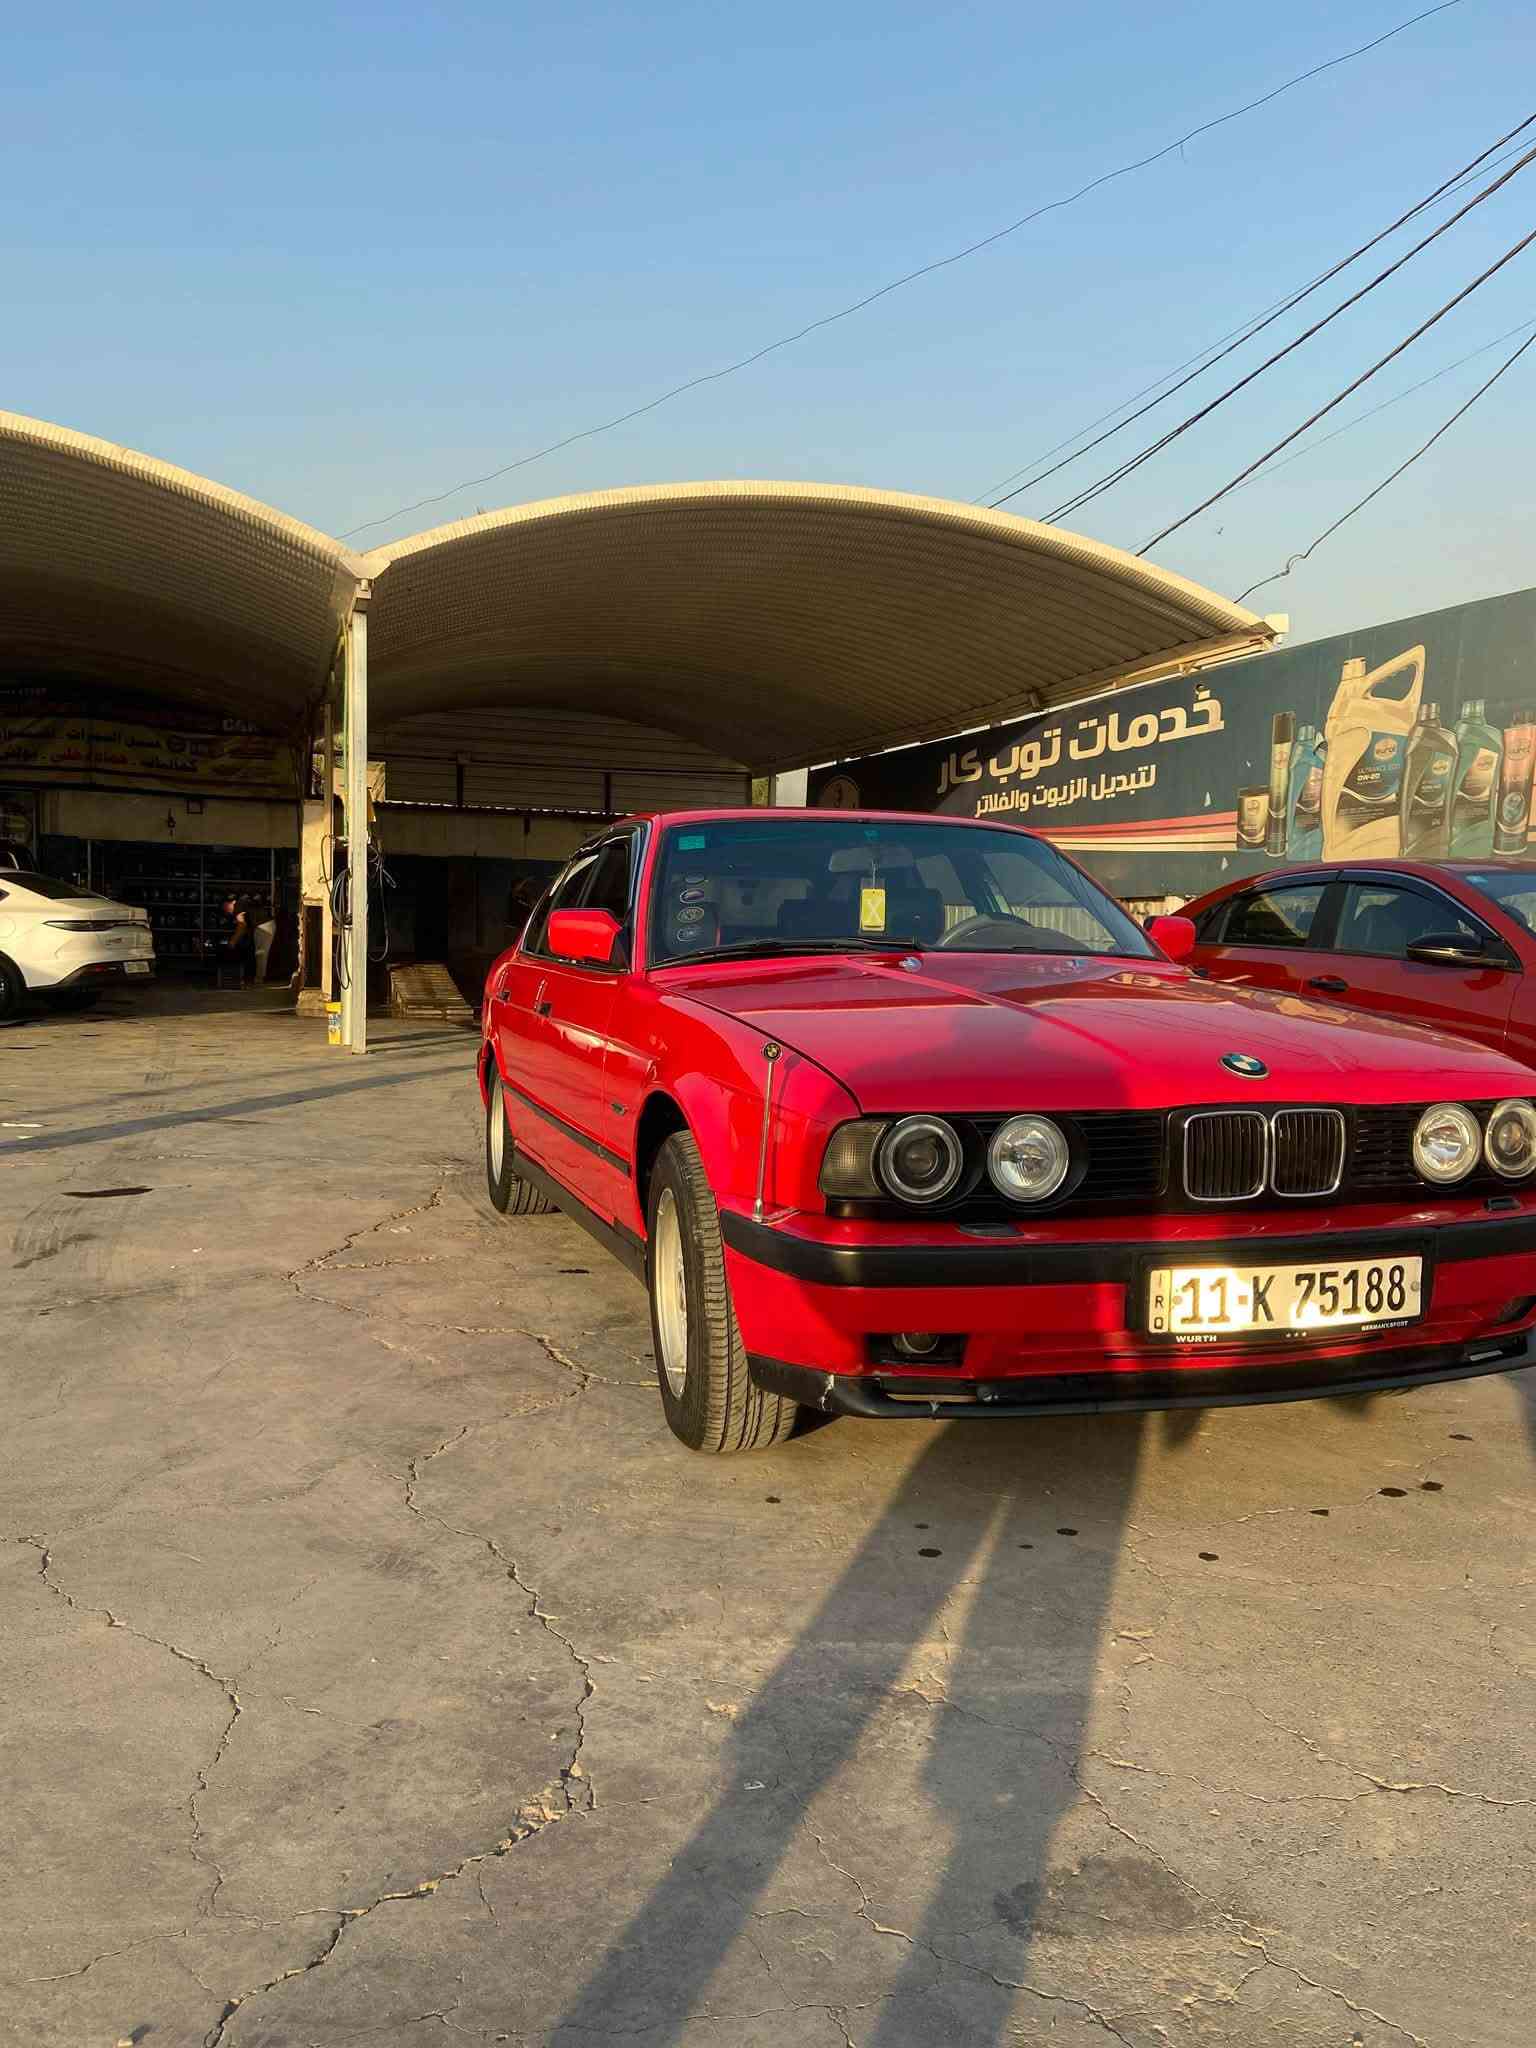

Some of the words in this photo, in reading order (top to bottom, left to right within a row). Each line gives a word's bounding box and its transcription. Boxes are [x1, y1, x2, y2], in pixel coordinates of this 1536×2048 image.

[1069, 689, 1225, 760] خدمات
[937, 751, 983, 793] كار
[989, 727, 1061, 783] توب
[975, 789, 1029, 818] والفلاتر
[1032, 776, 1088, 807] الزيوت
[1091, 764, 1156, 801] لتبديل
[1180, 1276, 1231, 1325] 11
[1251, 1274, 1276, 1323] K
[1294, 1264, 1406, 1321] 75188
